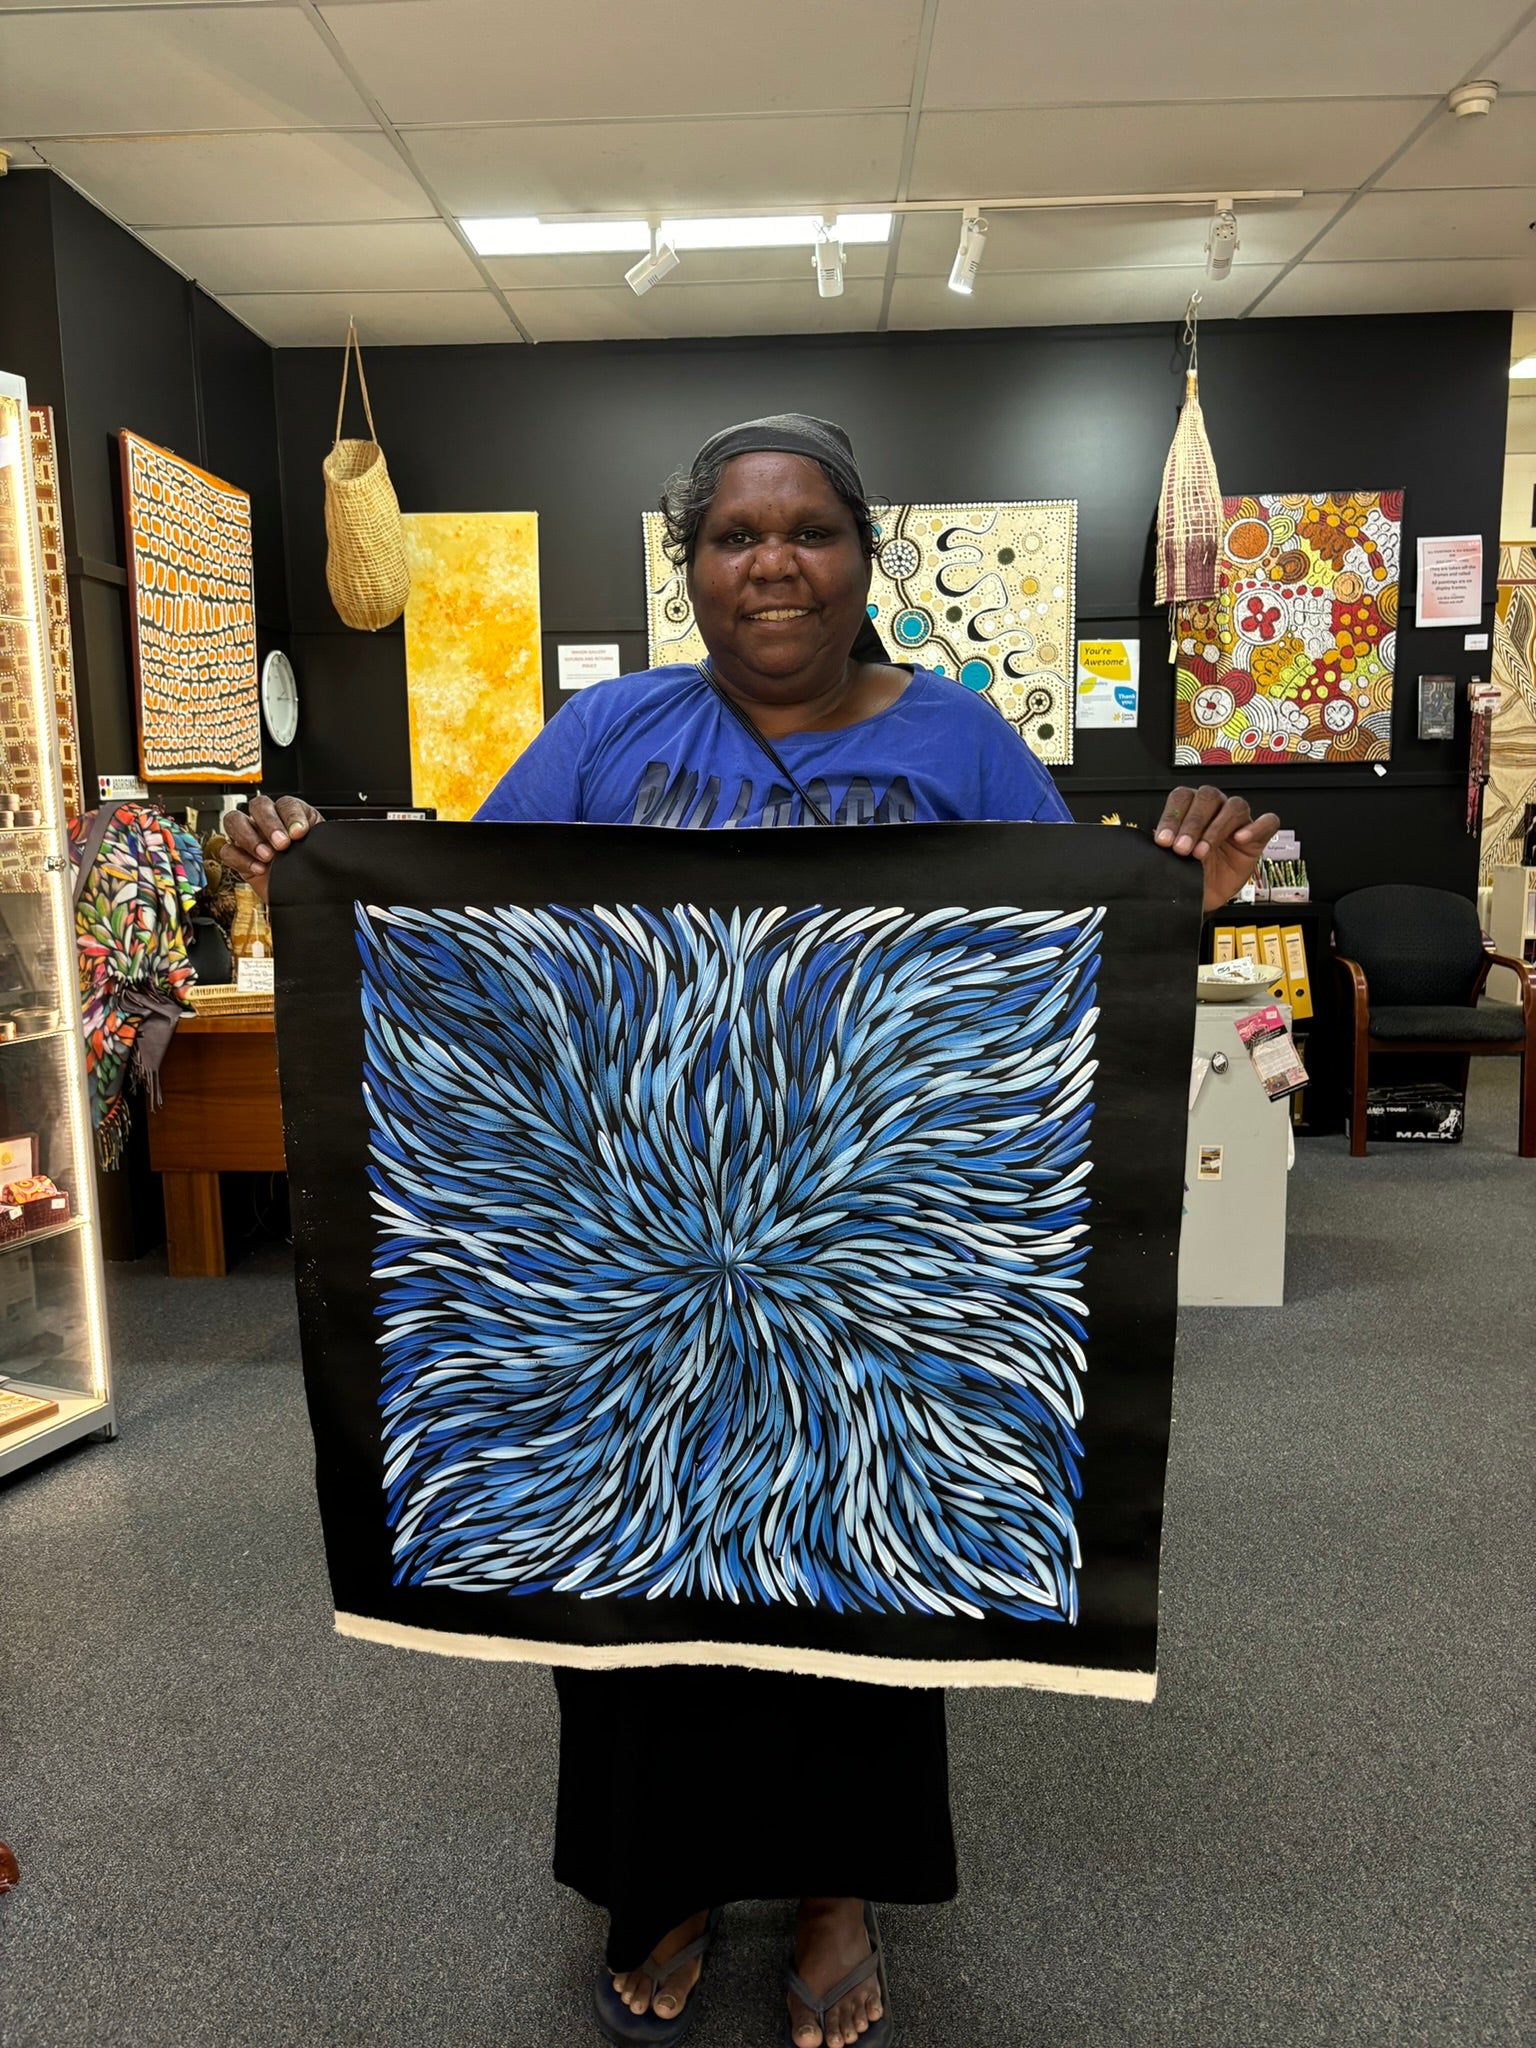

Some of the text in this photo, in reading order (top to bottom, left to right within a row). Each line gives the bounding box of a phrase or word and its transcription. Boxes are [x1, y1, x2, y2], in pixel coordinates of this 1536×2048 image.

[1083, 647, 1112, 656] You're
[1083, 658, 1125, 666] Awesome
[1395, 1131, 1454, 1139] MACK
